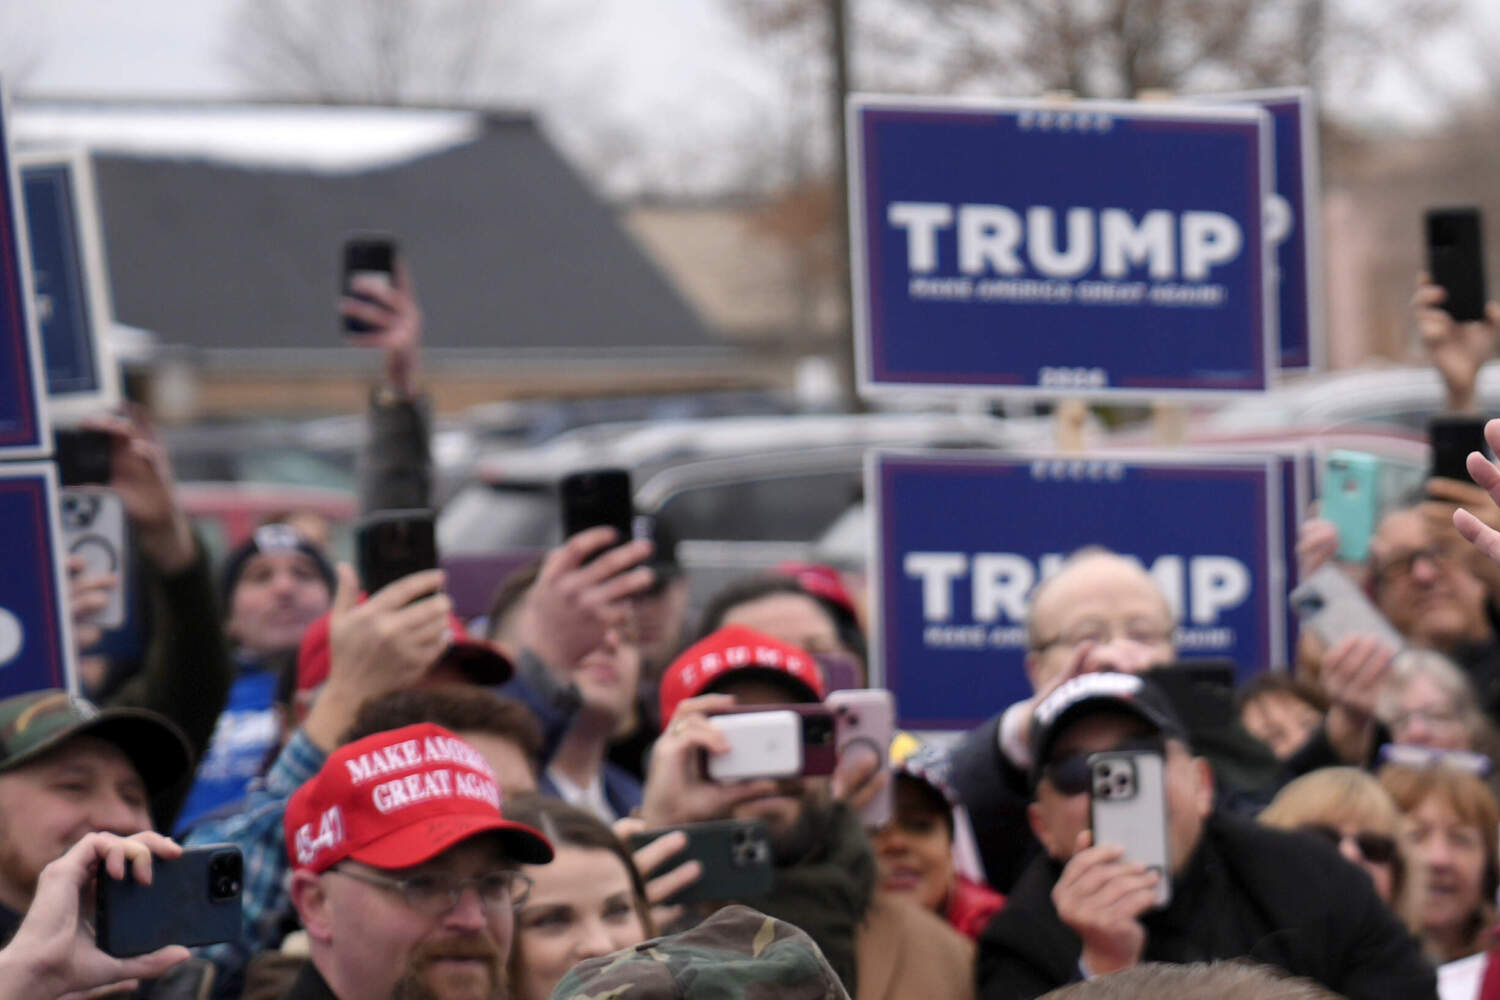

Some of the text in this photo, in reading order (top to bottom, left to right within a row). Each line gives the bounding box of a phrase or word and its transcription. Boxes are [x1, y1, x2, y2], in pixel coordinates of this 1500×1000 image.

[887, 201, 1243, 281] TRUMP
[345, 738, 422, 786] MAKE
[372, 769, 451, 814] GREAT
